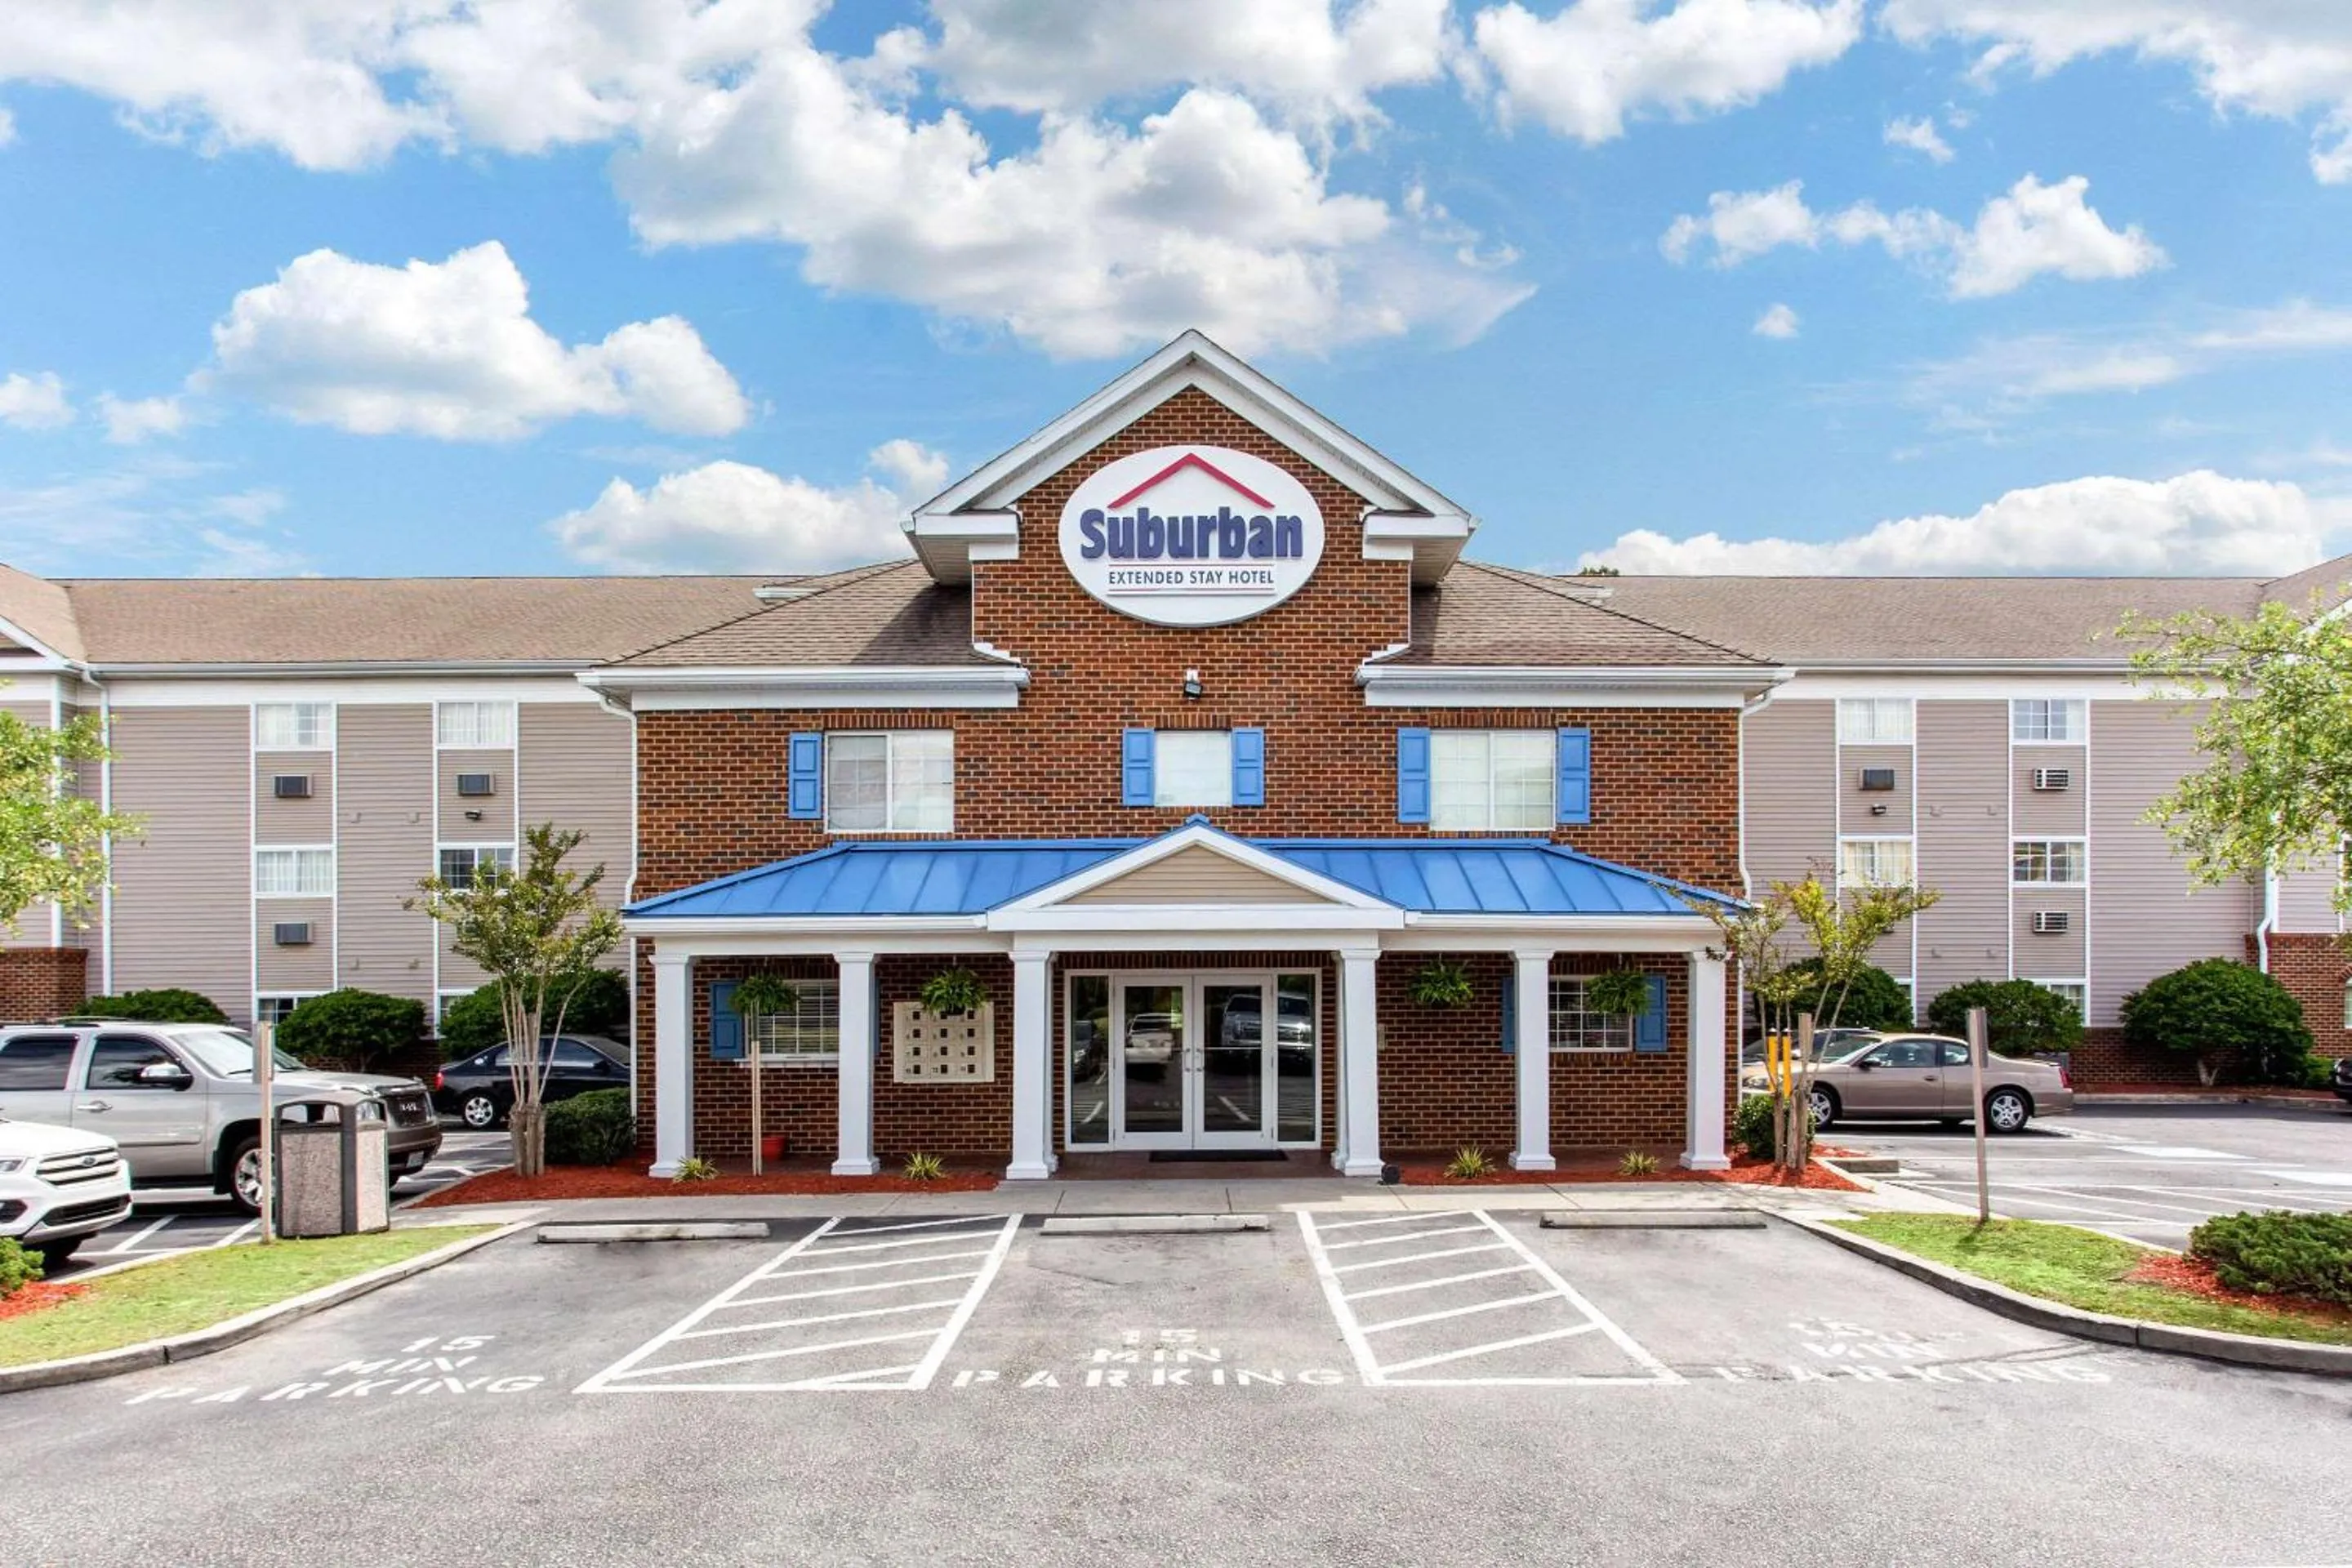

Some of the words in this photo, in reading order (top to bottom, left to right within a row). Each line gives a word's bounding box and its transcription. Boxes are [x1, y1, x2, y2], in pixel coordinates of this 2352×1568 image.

[1080, 506, 1303, 559] Suburban
[1108, 571, 1184, 585] EXTENDED
[1189, 571, 1223, 584] STAY
[1228, 570, 1274, 584] HOTEL
[401, 1335, 495, 1352] 15
[1120, 1329, 1198, 1343] 15
[1093, 1347, 1223, 1363] MIN
[323, 1356, 477, 1375] MIN
[952, 1368, 1345, 1388] PARKING
[122, 1375, 545, 1405] PARKING
